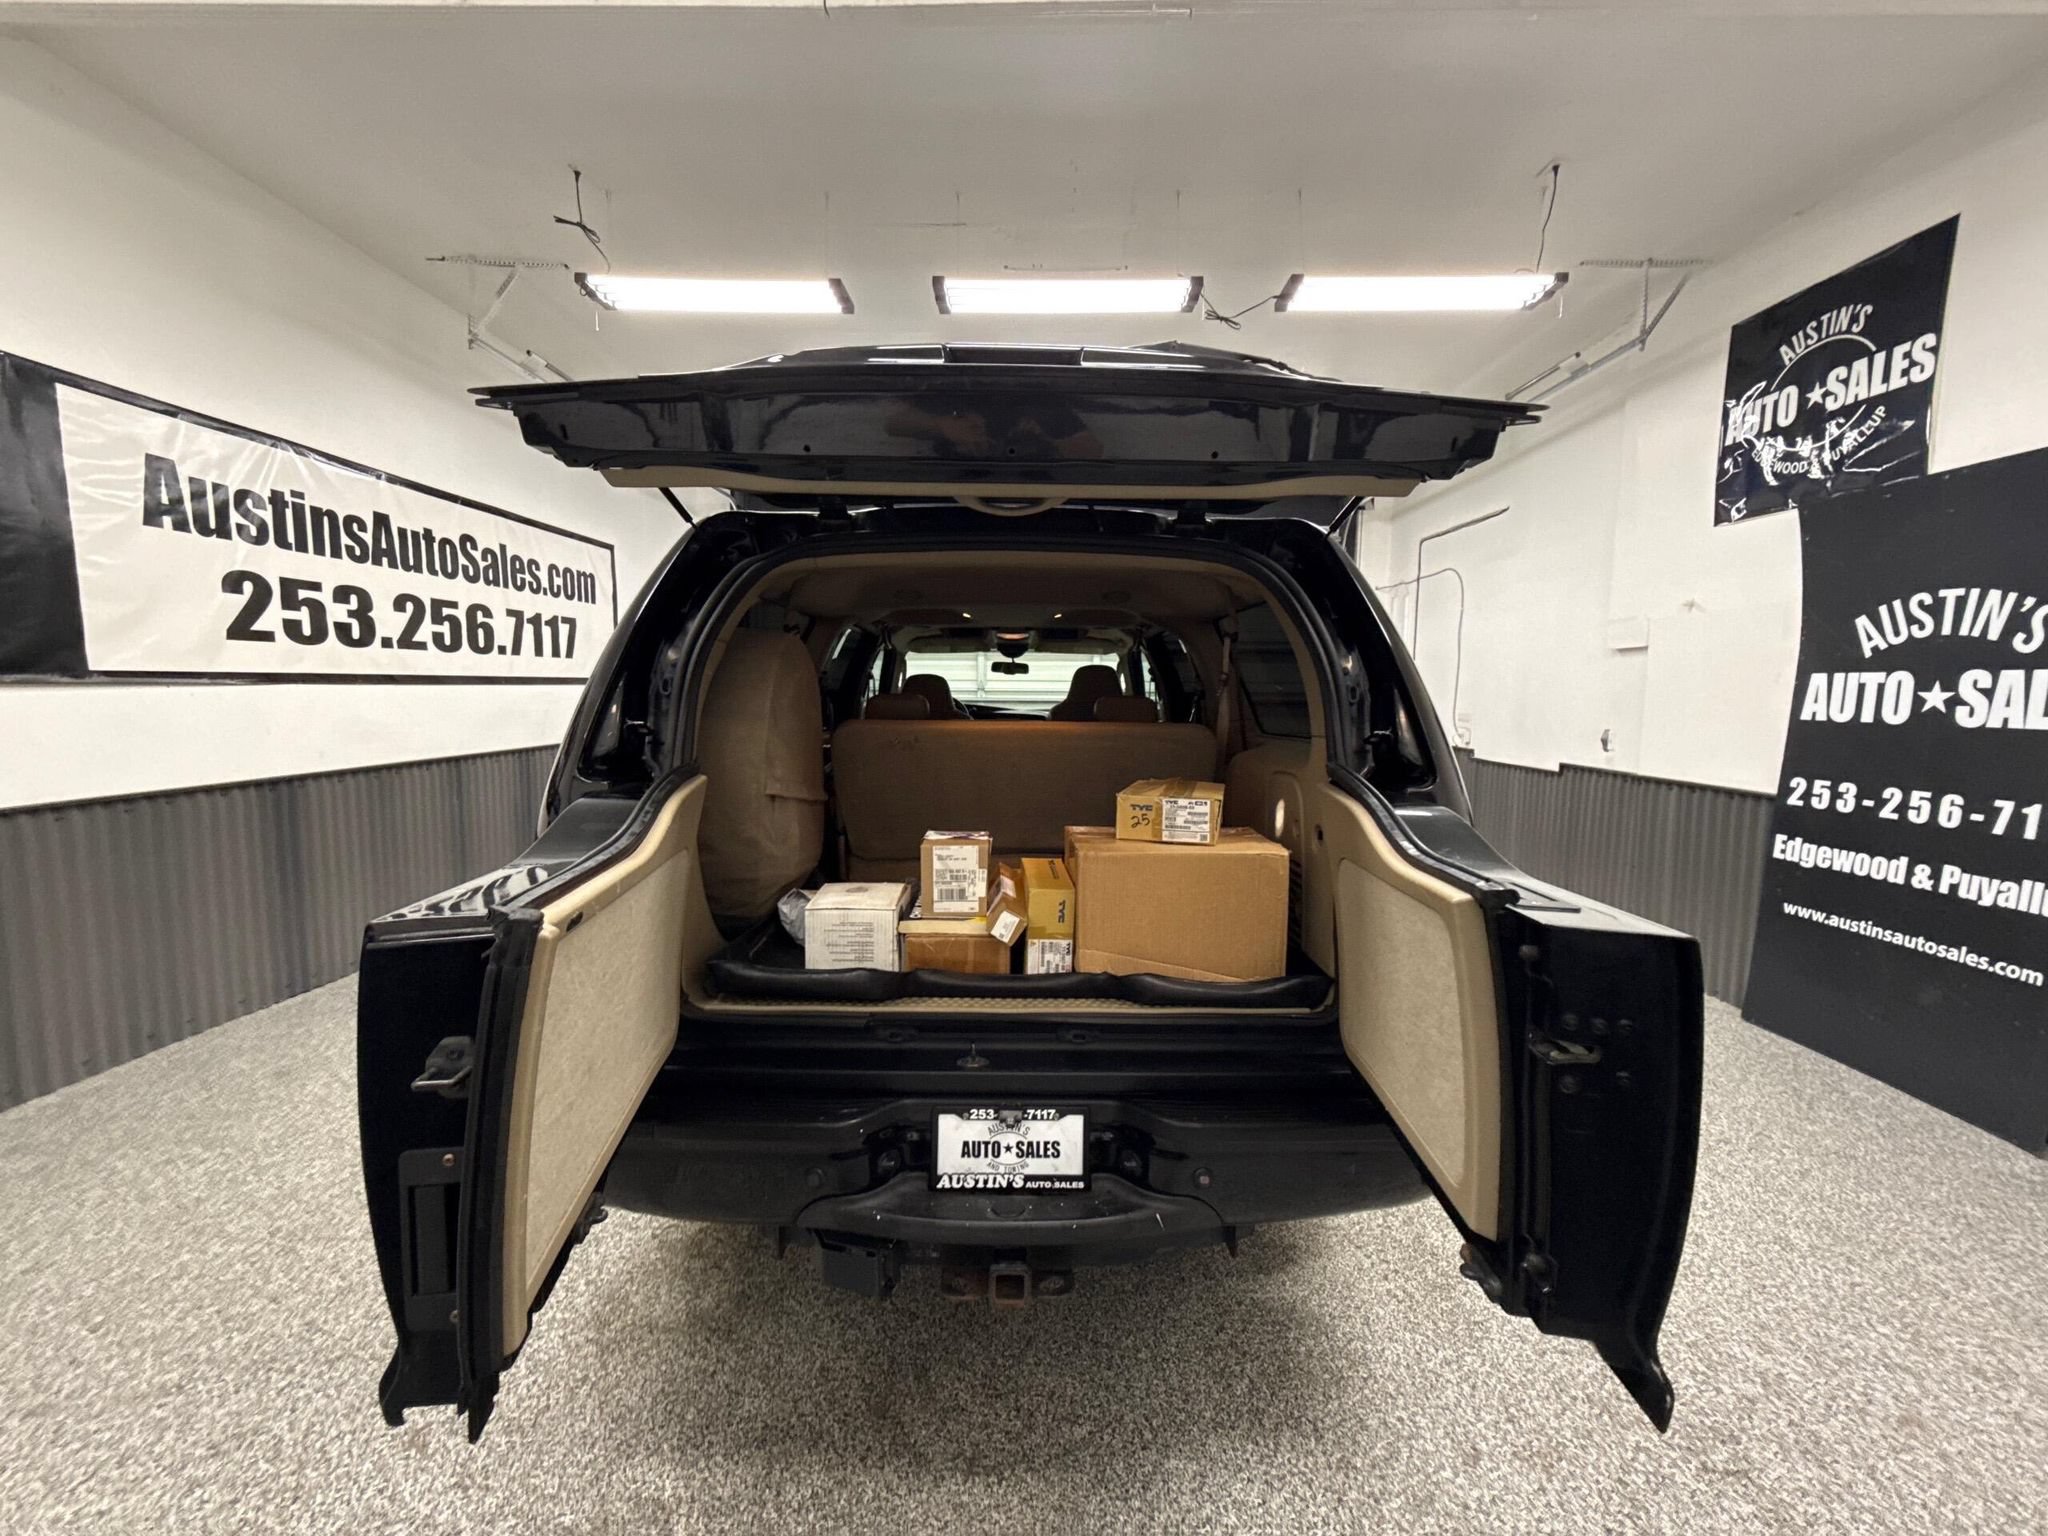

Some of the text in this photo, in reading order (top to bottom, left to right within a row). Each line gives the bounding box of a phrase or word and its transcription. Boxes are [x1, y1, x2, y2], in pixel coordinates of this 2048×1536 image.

[1778, 303, 1873, 366] AUSTIN'S
[1724, 332, 1937, 447] AUTO SALES
[142, 453, 596, 604] AustinsAutoSales.com
[221, 570, 577, 659] 253.256.7117
[1854, 587, 2048, 658] AUSTIN'S
[1799, 670, 1915, 725] AUTO
[1130, 813, 1151, 829] 25
[1772, 833, 1909, 885] Edgewood
[1911, 863, 1935, 891] &
[1057, 899, 1066, 923] TYC
[1782, 901, 2044, 987] www.austinsautosales.com
[961, 1140, 1061, 1159] AUTO SALES
[936, 1173, 1085, 1189] AUSTIN'S AUTO SALES
